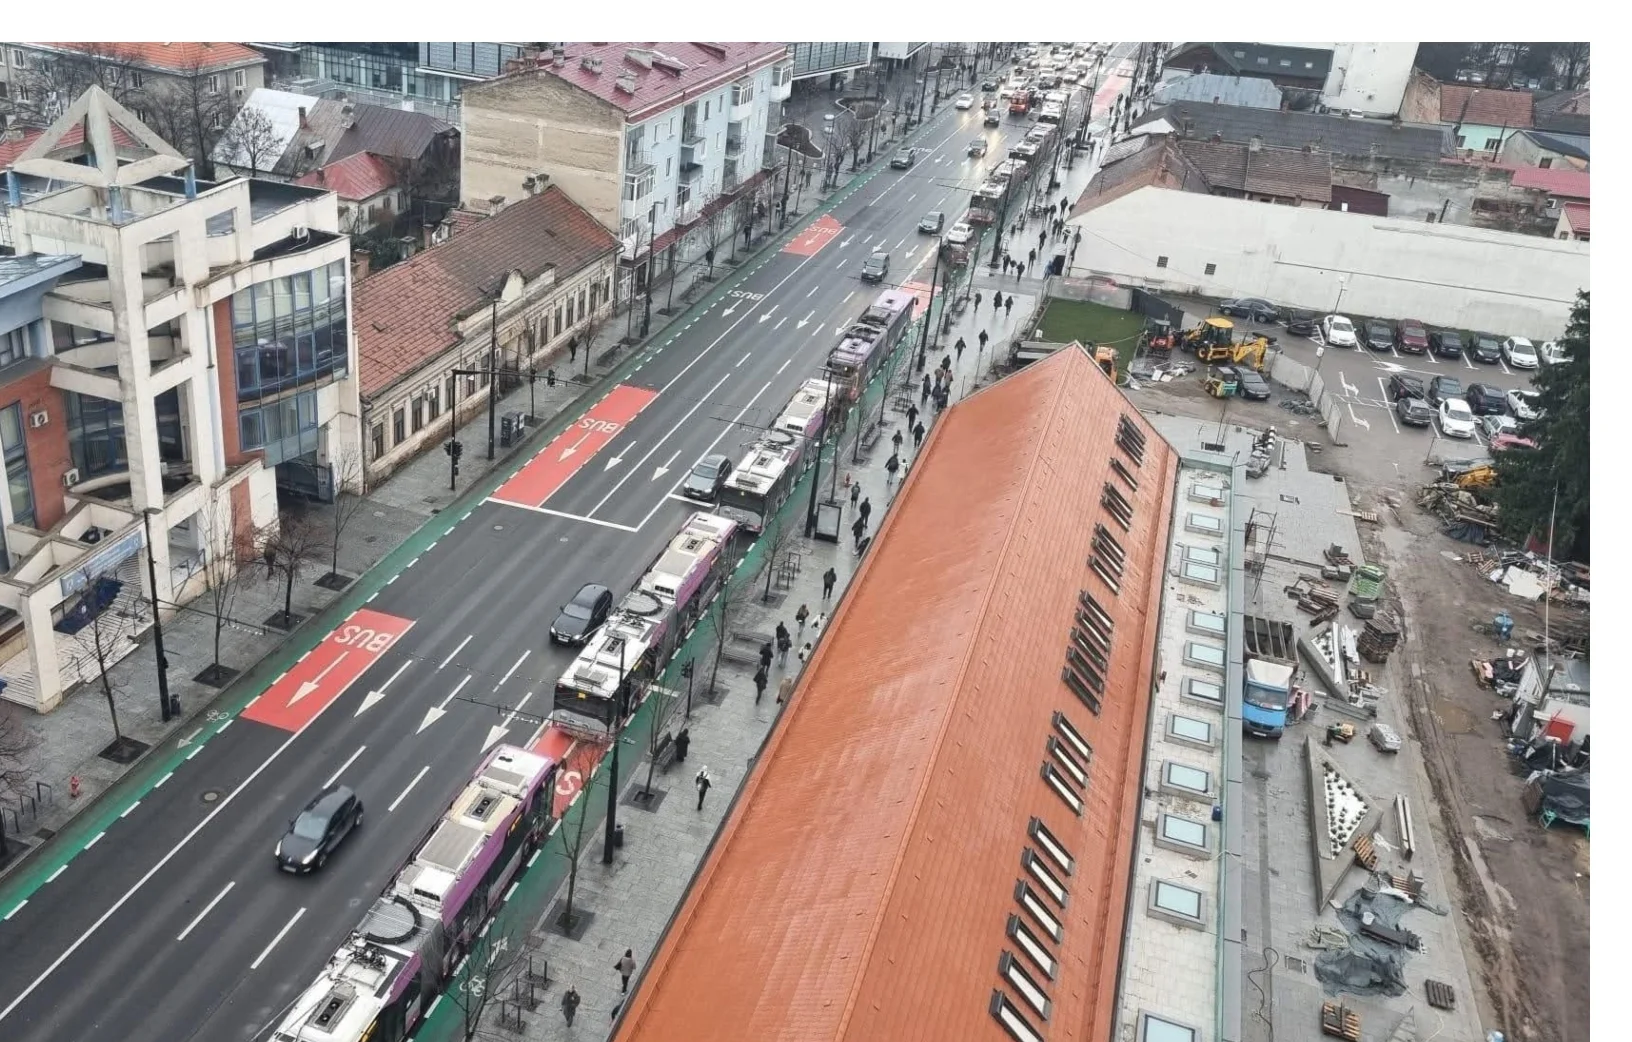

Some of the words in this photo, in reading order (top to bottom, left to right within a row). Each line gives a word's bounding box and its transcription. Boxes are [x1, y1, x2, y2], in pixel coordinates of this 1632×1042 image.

[731, 290, 764, 301] BUS
[577, 418, 620, 434] BUS
[334, 625, 394, 652] BUS
